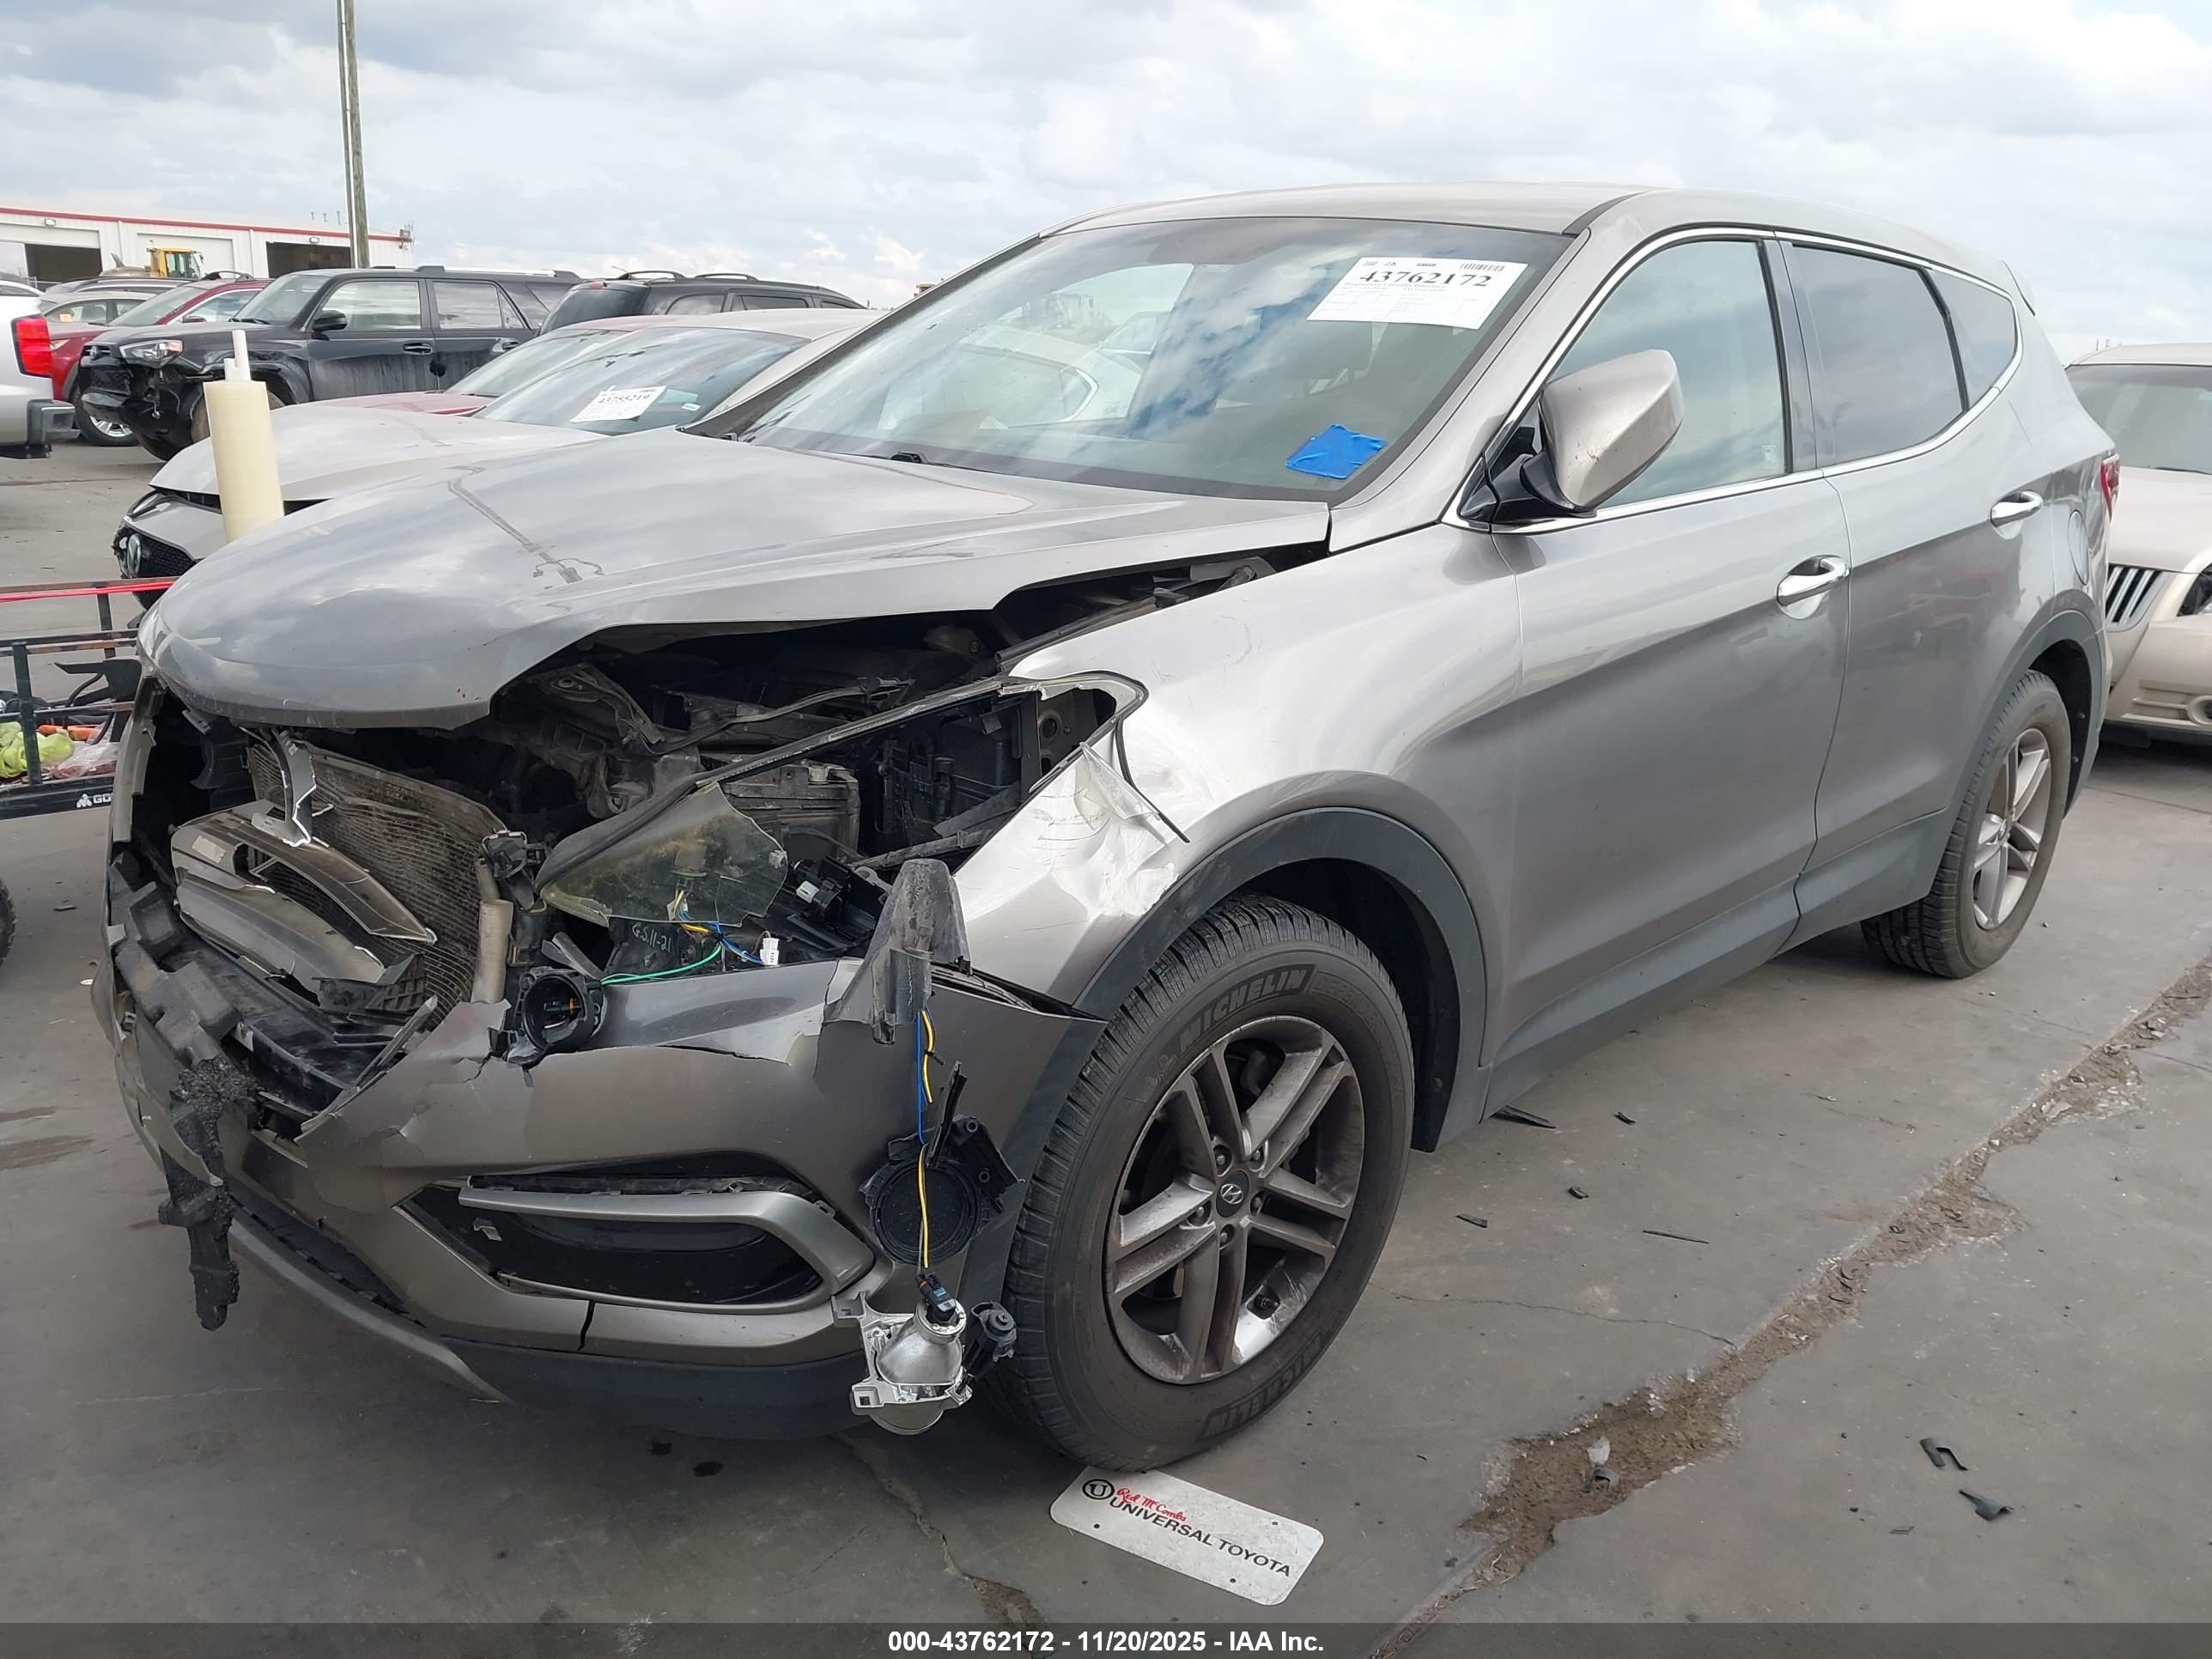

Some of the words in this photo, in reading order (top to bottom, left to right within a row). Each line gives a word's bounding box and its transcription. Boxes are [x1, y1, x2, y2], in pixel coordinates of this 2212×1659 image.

[1359, 270, 1492, 288] 43762172
[1179, 968, 1309, 1054] MICHELIN
[1116, 1487, 1141, 1504] Red
[1109, 1496, 1213, 1547] UNIVERSAL
[1218, 1538, 1291, 1577] TOYOTA
